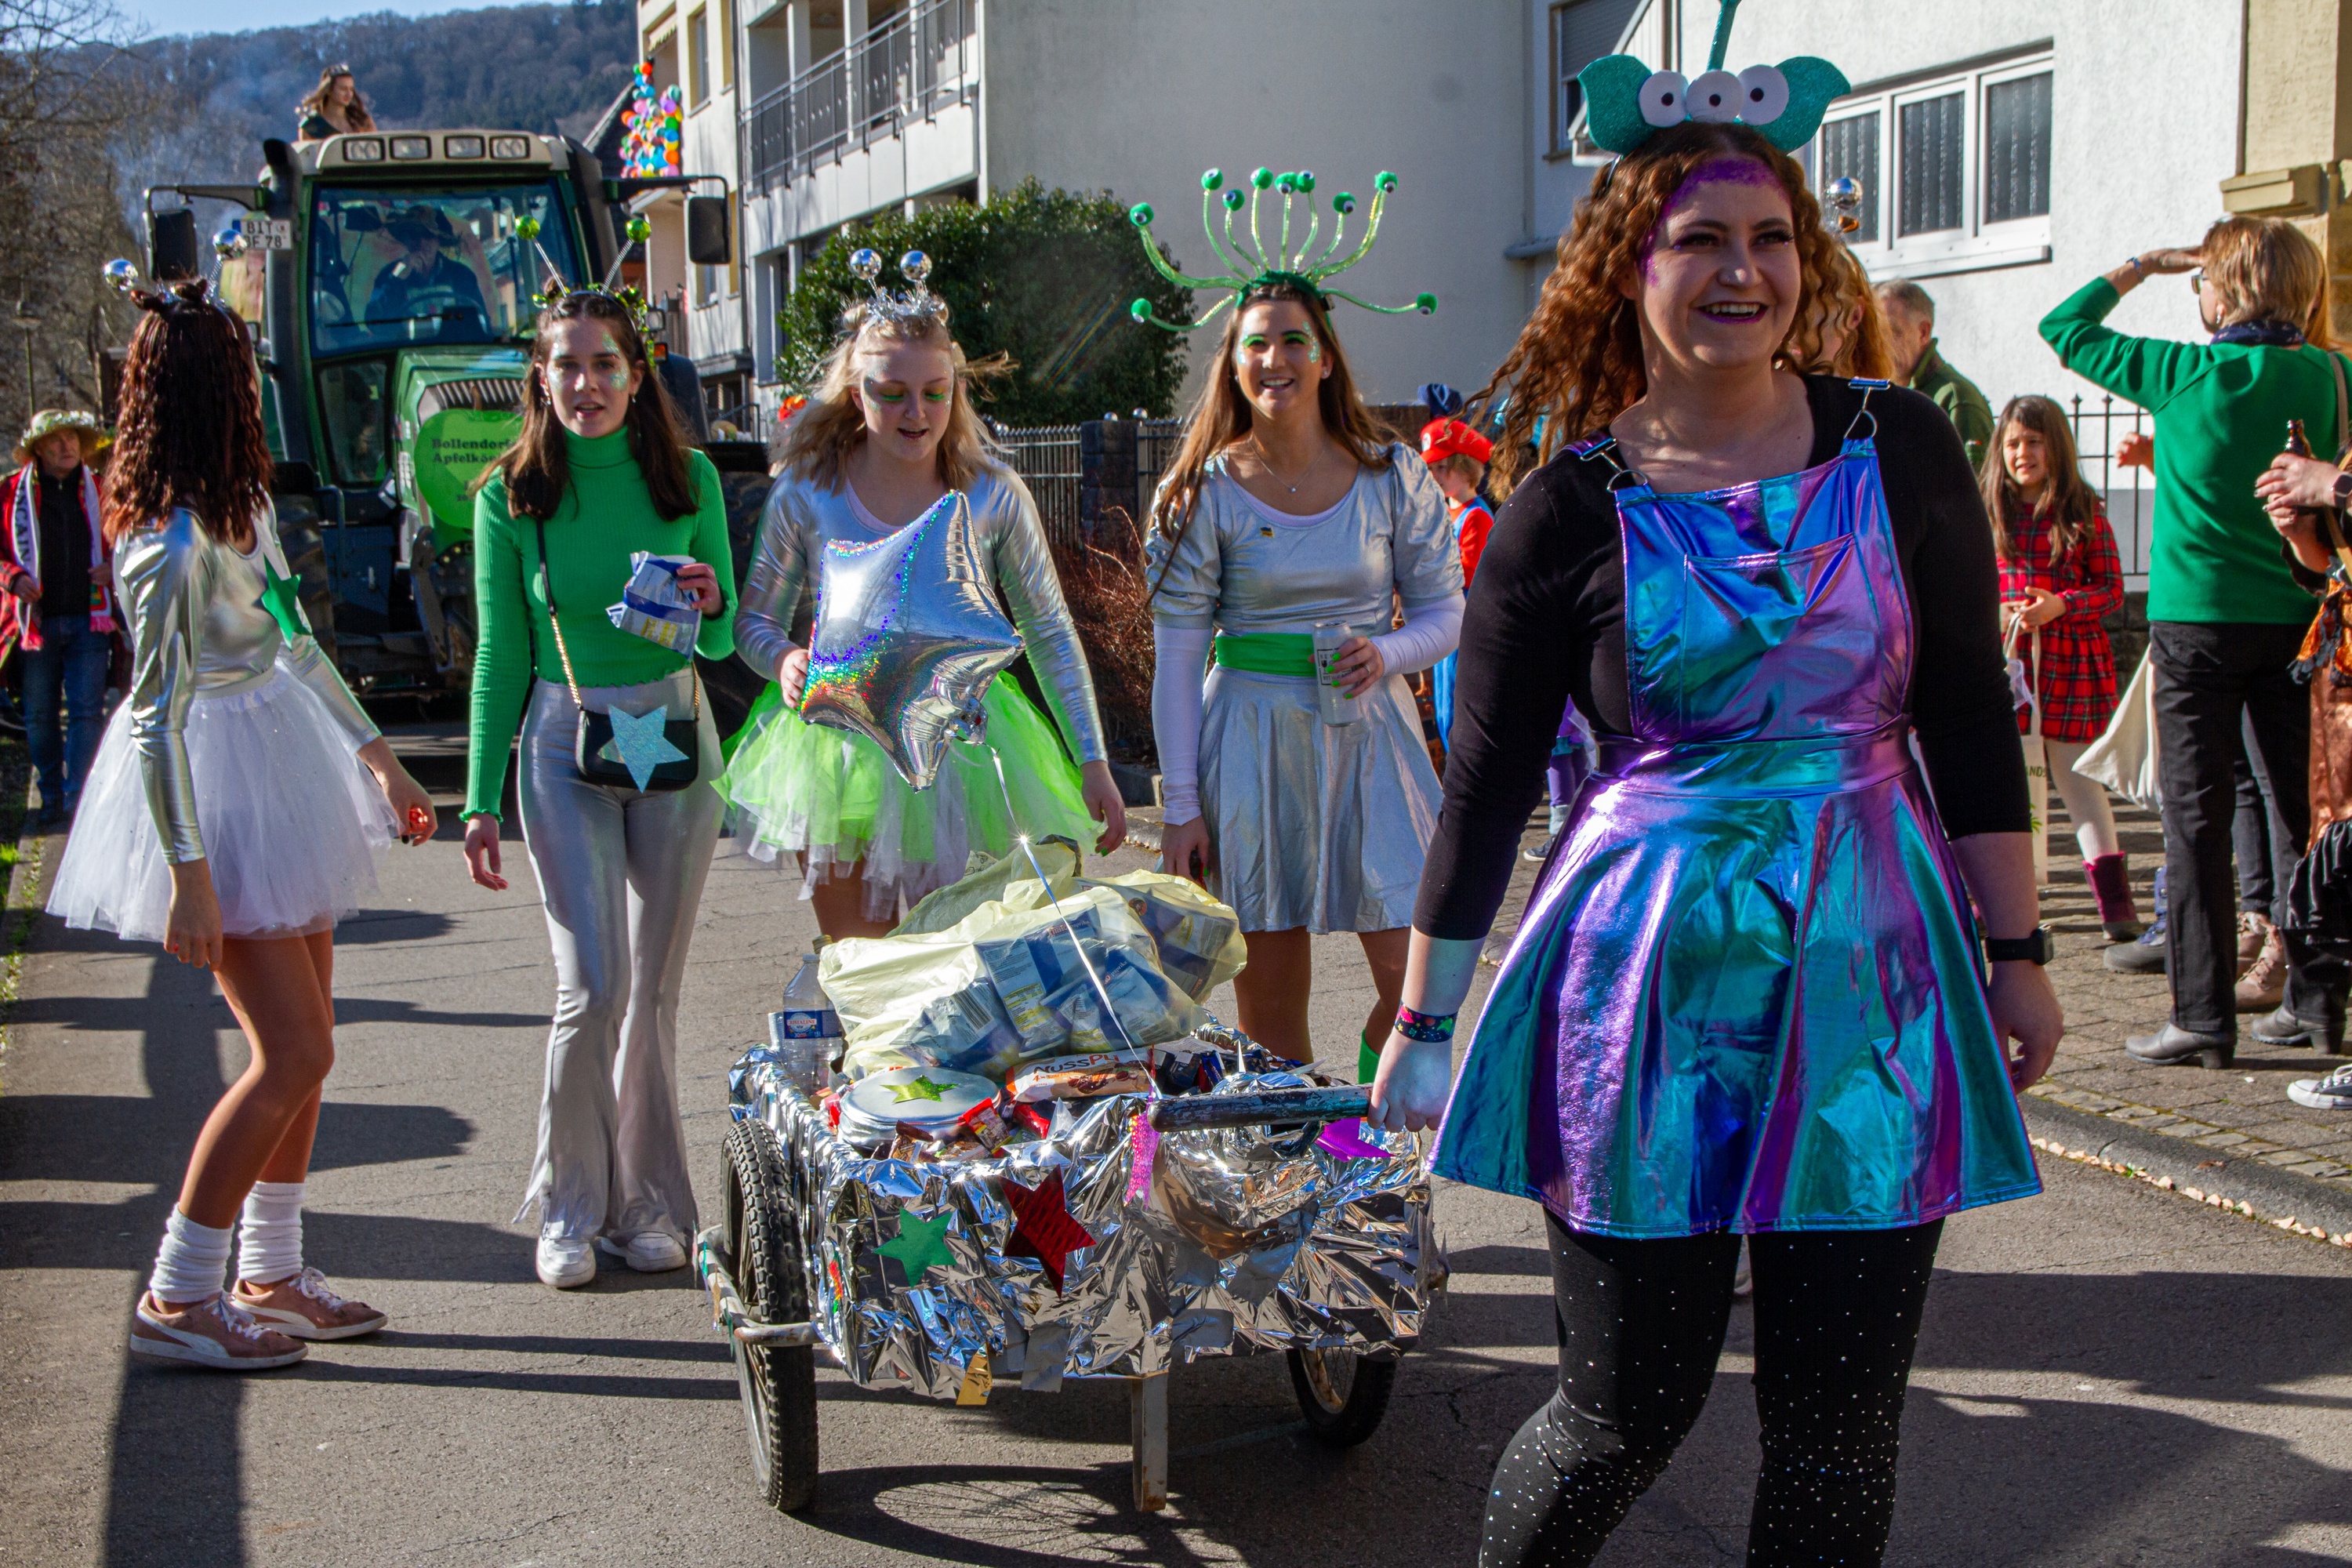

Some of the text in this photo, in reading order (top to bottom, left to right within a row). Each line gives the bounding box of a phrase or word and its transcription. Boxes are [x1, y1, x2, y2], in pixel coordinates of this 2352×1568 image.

[247, 221, 272, 234] BIT
[266, 235, 281, 248] 78
[433, 438, 512, 448] Bollendorf
[1111, 961, 1127, 977] paprika
